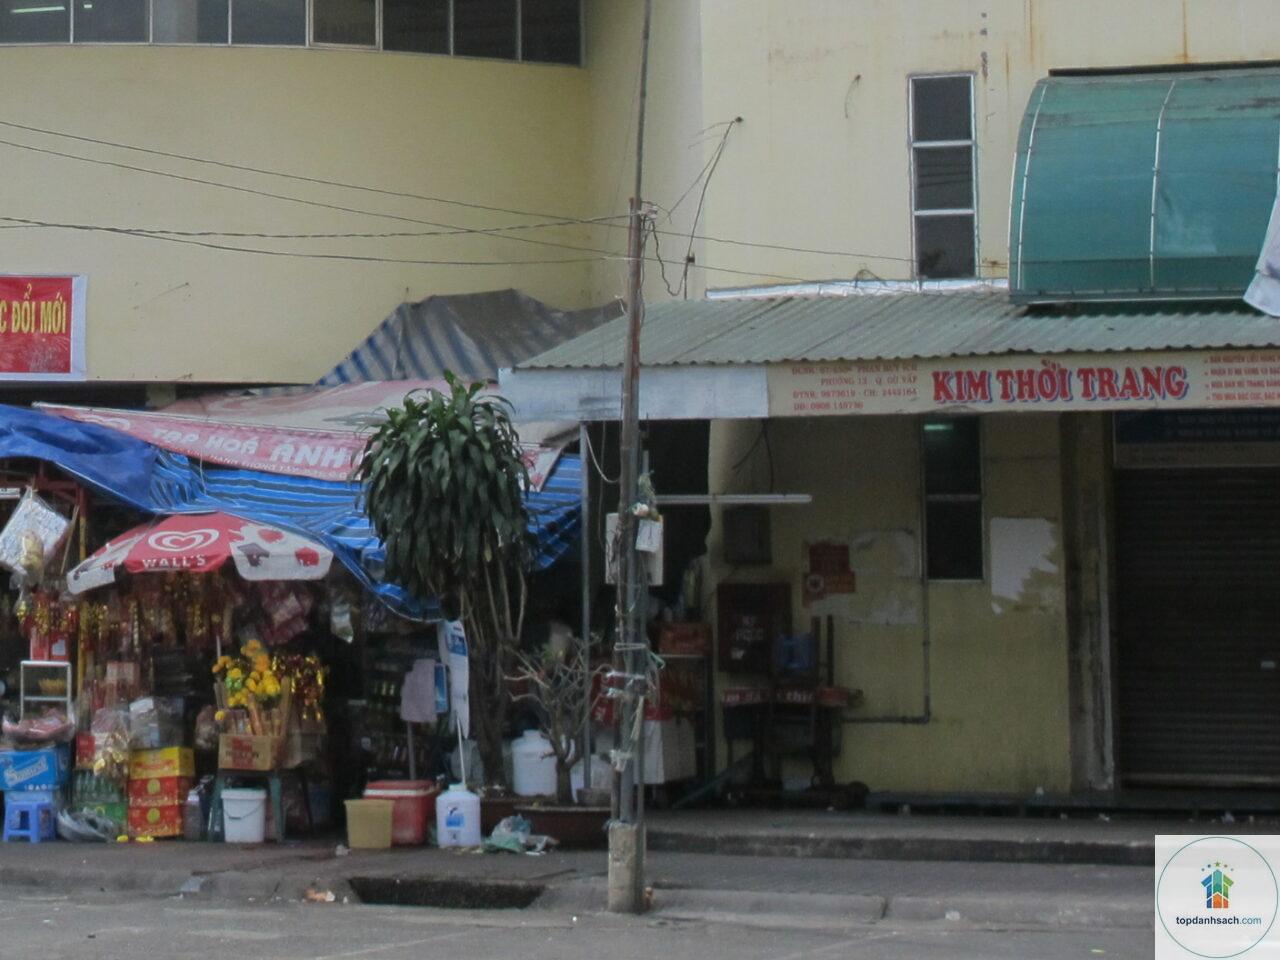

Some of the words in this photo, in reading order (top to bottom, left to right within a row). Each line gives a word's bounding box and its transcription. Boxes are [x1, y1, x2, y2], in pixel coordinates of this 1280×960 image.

[11, 283, 36, 333] ĐỔI
[39, 292, 66, 334] MỚI
[932, 370, 990, 403] KIM
[1077, 366, 1188, 401] TRANG
[142, 554, 206, 568] WALL'S
